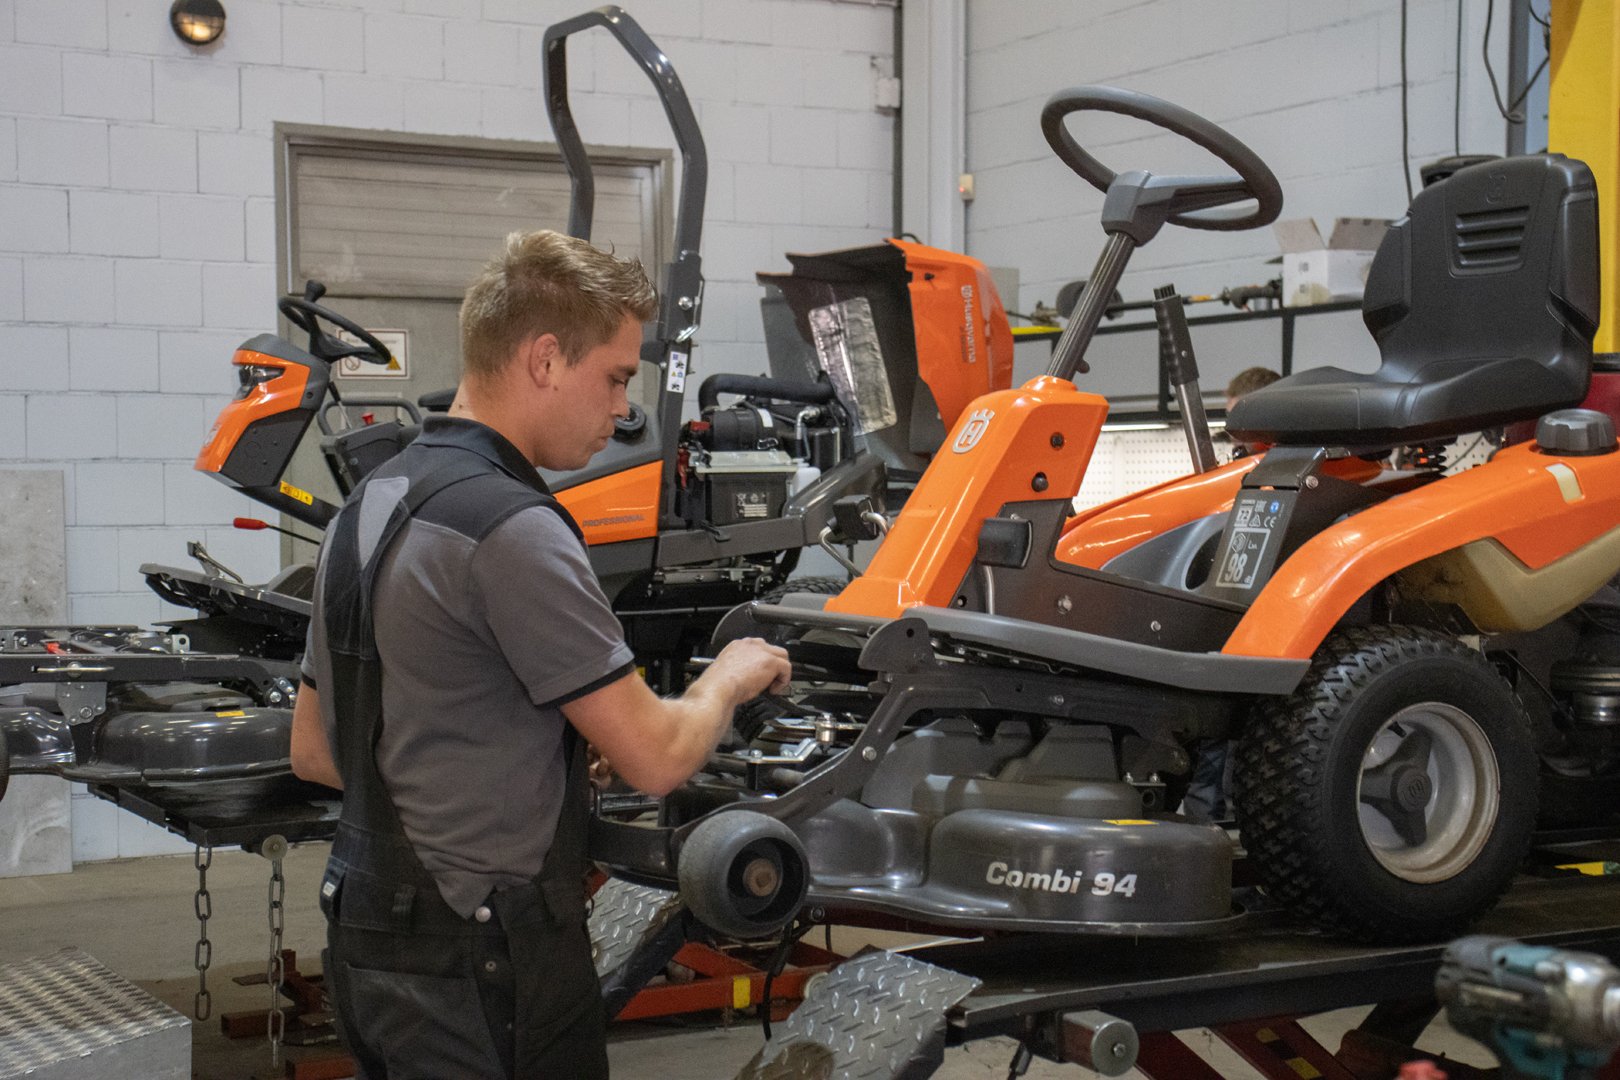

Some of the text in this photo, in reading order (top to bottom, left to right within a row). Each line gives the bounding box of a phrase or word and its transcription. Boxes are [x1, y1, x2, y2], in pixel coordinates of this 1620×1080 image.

[964, 299, 976, 363] Husqvarna
[582, 514, 645, 527] PROFESSIONAL
[1225, 553, 1248, 582] 98
[985, 861, 1138, 898] Combi 94
